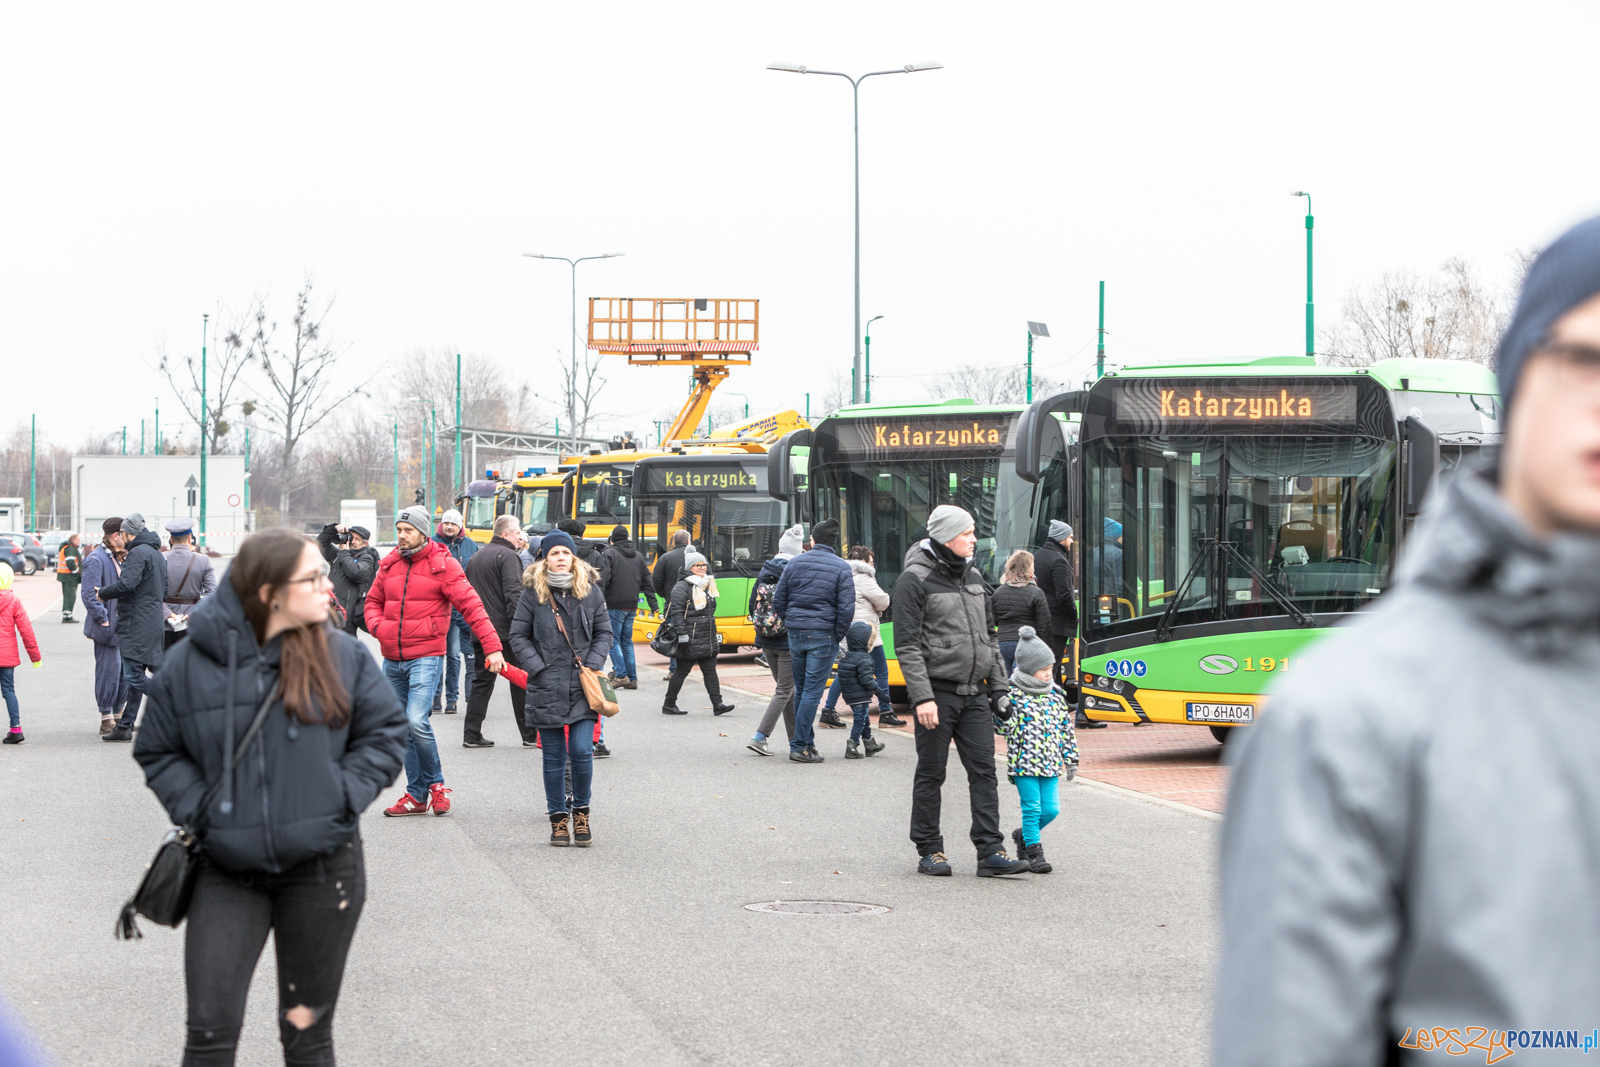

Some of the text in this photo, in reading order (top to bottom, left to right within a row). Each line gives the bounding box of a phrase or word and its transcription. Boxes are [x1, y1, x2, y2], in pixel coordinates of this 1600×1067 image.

[1161, 390, 1312, 419] Katarzynka
[875, 423, 999, 447] Katarzynka
[665, 471, 757, 488] Katarzynka
[1243, 656, 1302, 673] 191
[1194, 705, 1210, 718] PO
